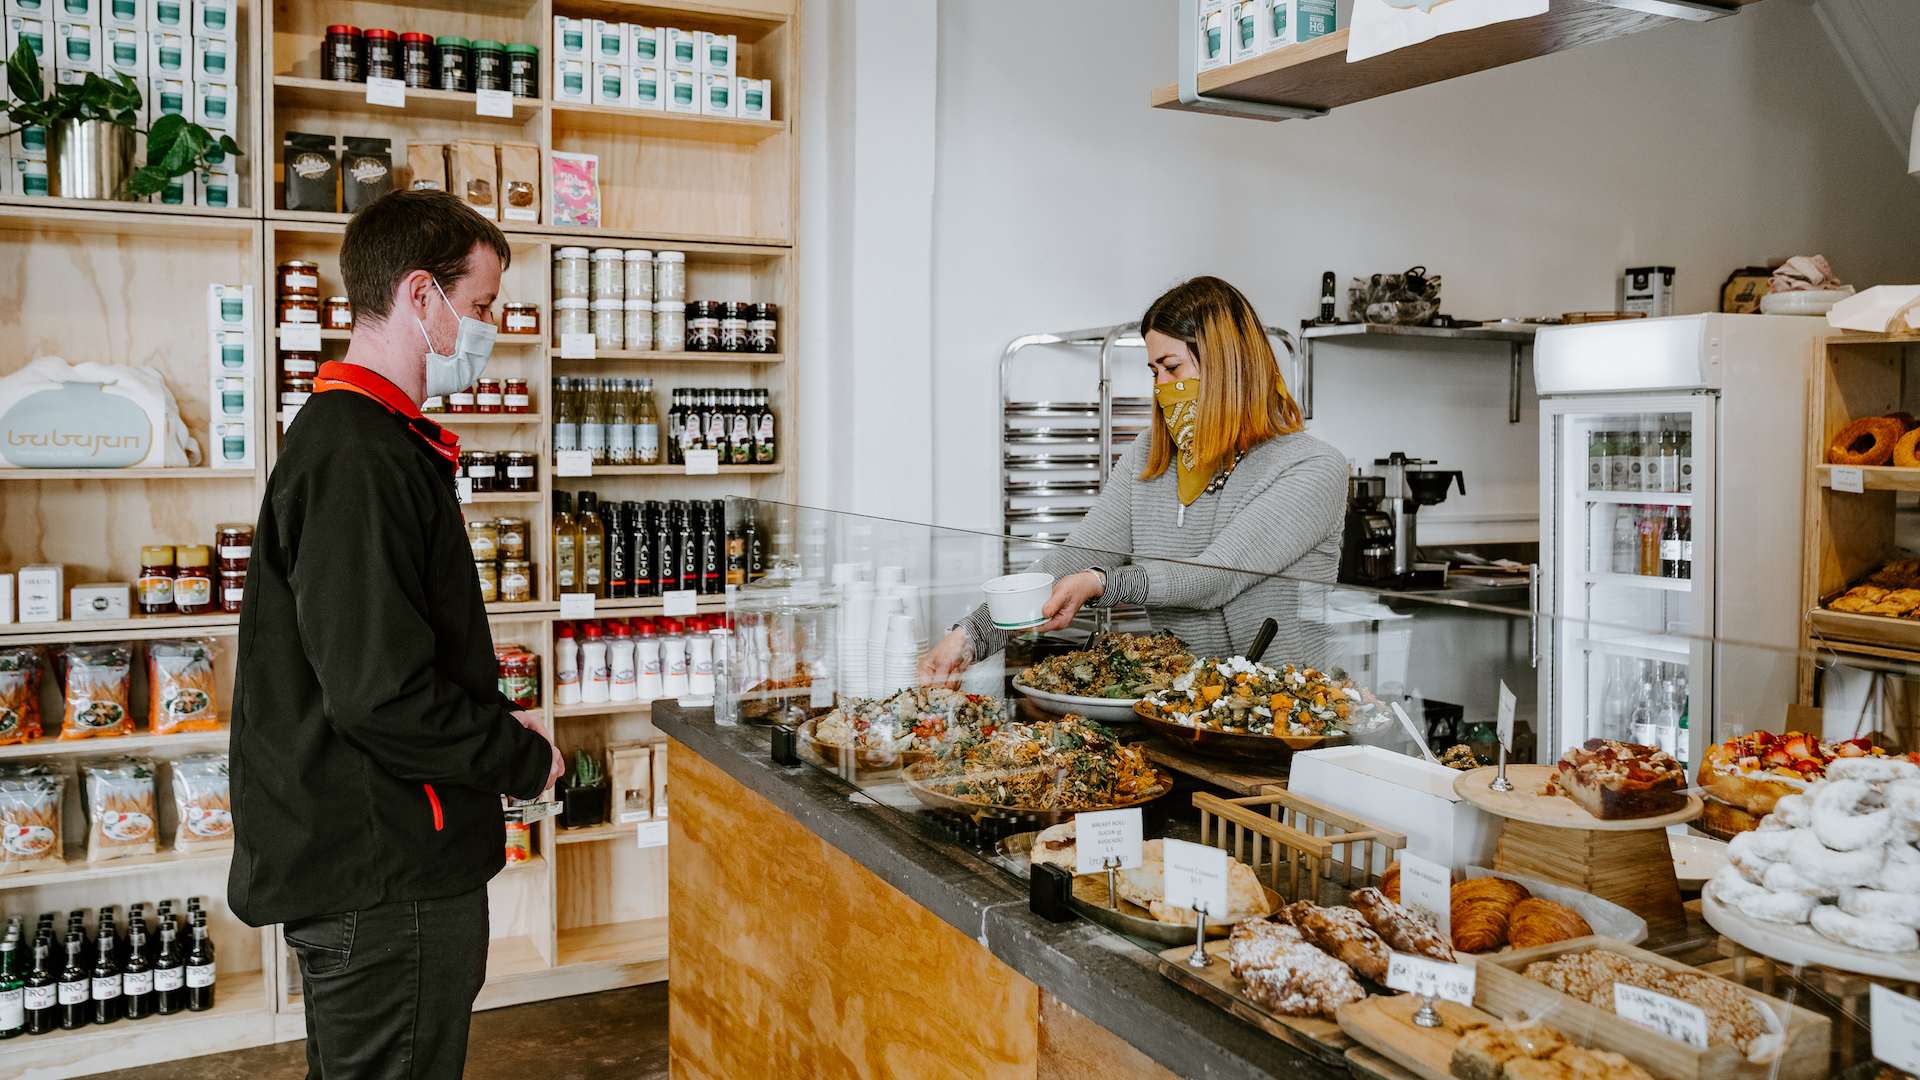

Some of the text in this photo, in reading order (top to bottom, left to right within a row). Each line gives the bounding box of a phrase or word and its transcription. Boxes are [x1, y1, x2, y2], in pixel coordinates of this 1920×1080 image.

[7, 429, 139, 457] babajan
[614, 545, 623, 578] ALTO
[639, 545, 648, 577] ALTO
[663, 544, 672, 576] ALTO
[686, 540, 694, 571] ALTO
[707, 539, 716, 571] ALTO
[753, 539, 761, 571] ALTO
